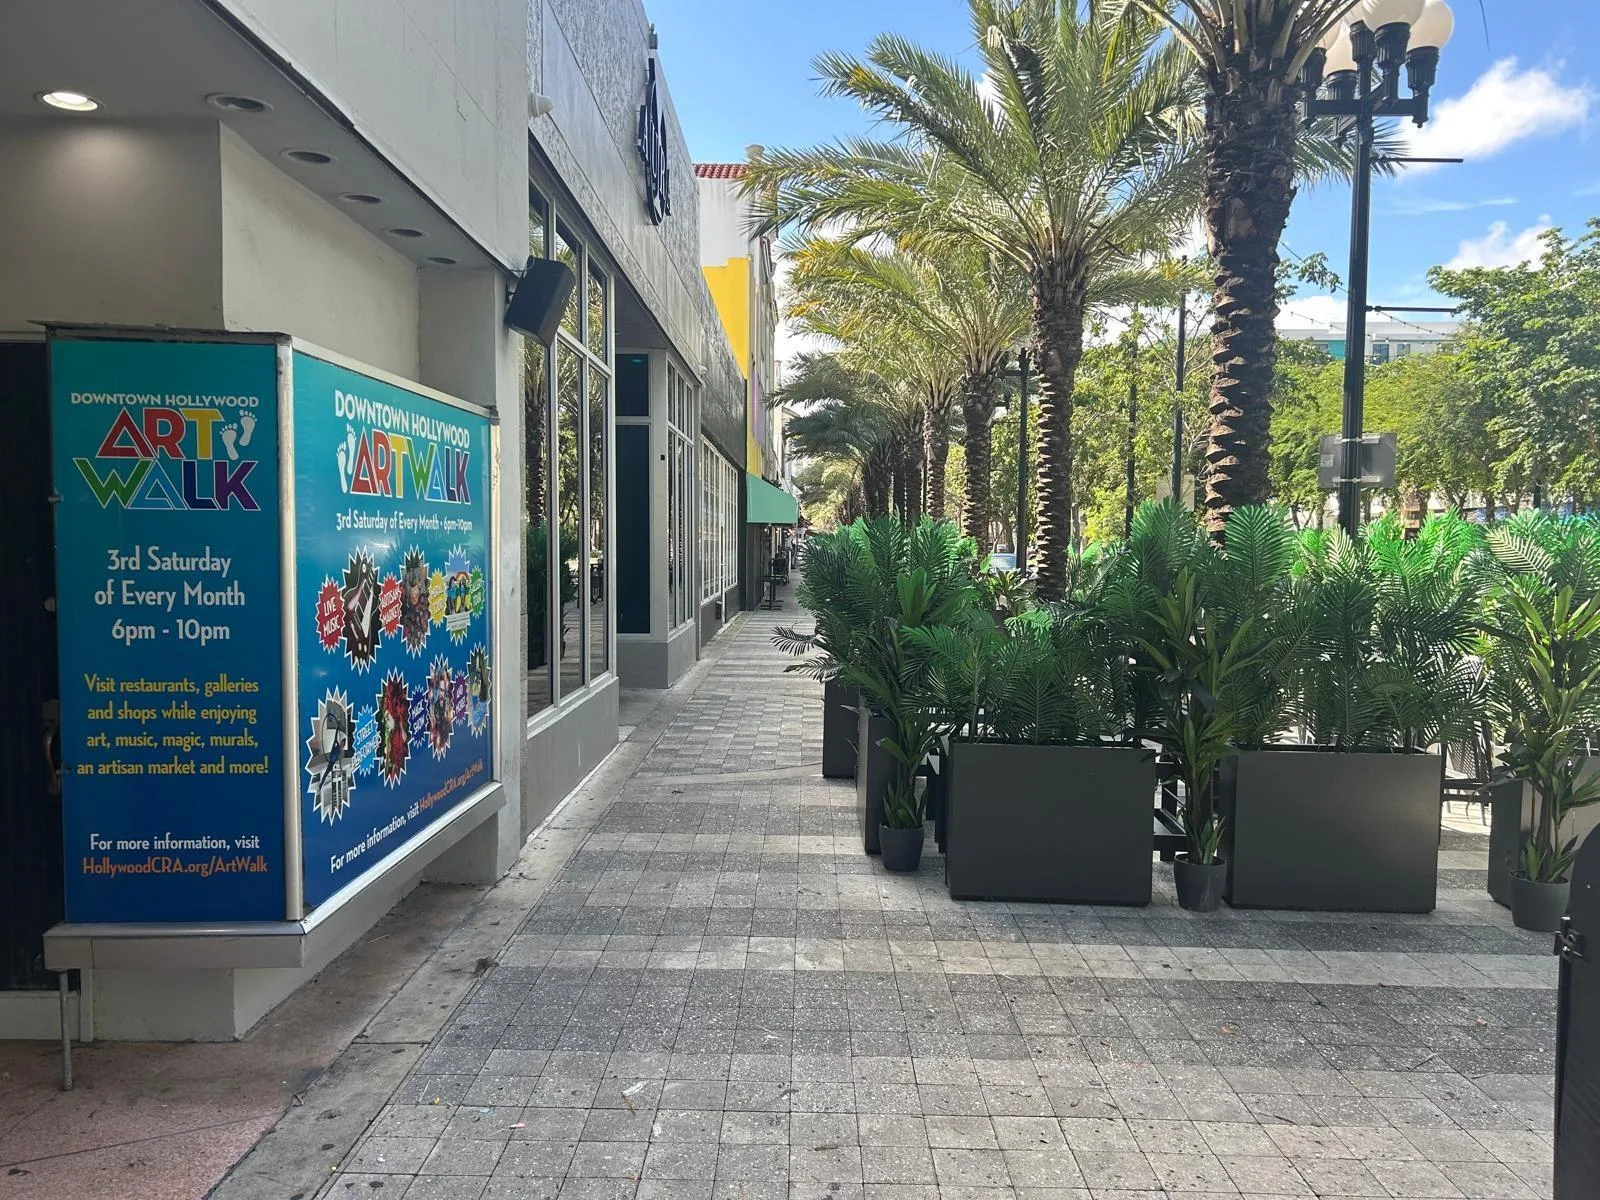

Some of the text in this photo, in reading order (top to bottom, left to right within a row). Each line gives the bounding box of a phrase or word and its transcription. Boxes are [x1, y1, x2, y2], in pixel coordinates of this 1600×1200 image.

[71, 393, 259, 408] DOWNTOWN HOLLYWOOD
[334, 389, 470, 449] DOWNTOWN HOLLYWOOD
[95, 406, 225, 460] ART
[73, 457, 261, 511] WALK
[336, 508, 352, 531] 3rd
[353, 509, 387, 534] Saturday
[389, 510, 398, 529] of
[399, 511, 418, 534] Every
[419, 513, 439, 530] Month
[107, 545, 232, 578] 3rd Saturday
[94, 579, 245, 612] of Every Month
[323, 596, 337, 617] LIVE
[112, 618, 155, 646] 6pm
[176, 618, 230, 646] 10pm
[323, 614, 341, 638] MUSIC
[84, 673, 259, 697] Visit restaurants, galleries
[88, 700, 257, 724] and shops while enjoying
[87, 727, 259, 752] art, music, magic, murals,
[77, 755, 269, 774] an artisan market and more!
[90, 832, 260, 851] For more information, visit
[330, 854, 345, 874] For
[346, 841, 366, 862] more
[366, 815, 407, 850] information,
[407, 801, 420, 820] visit
[82, 856, 268, 878] HollywoodCRA.org/ArtWalk
